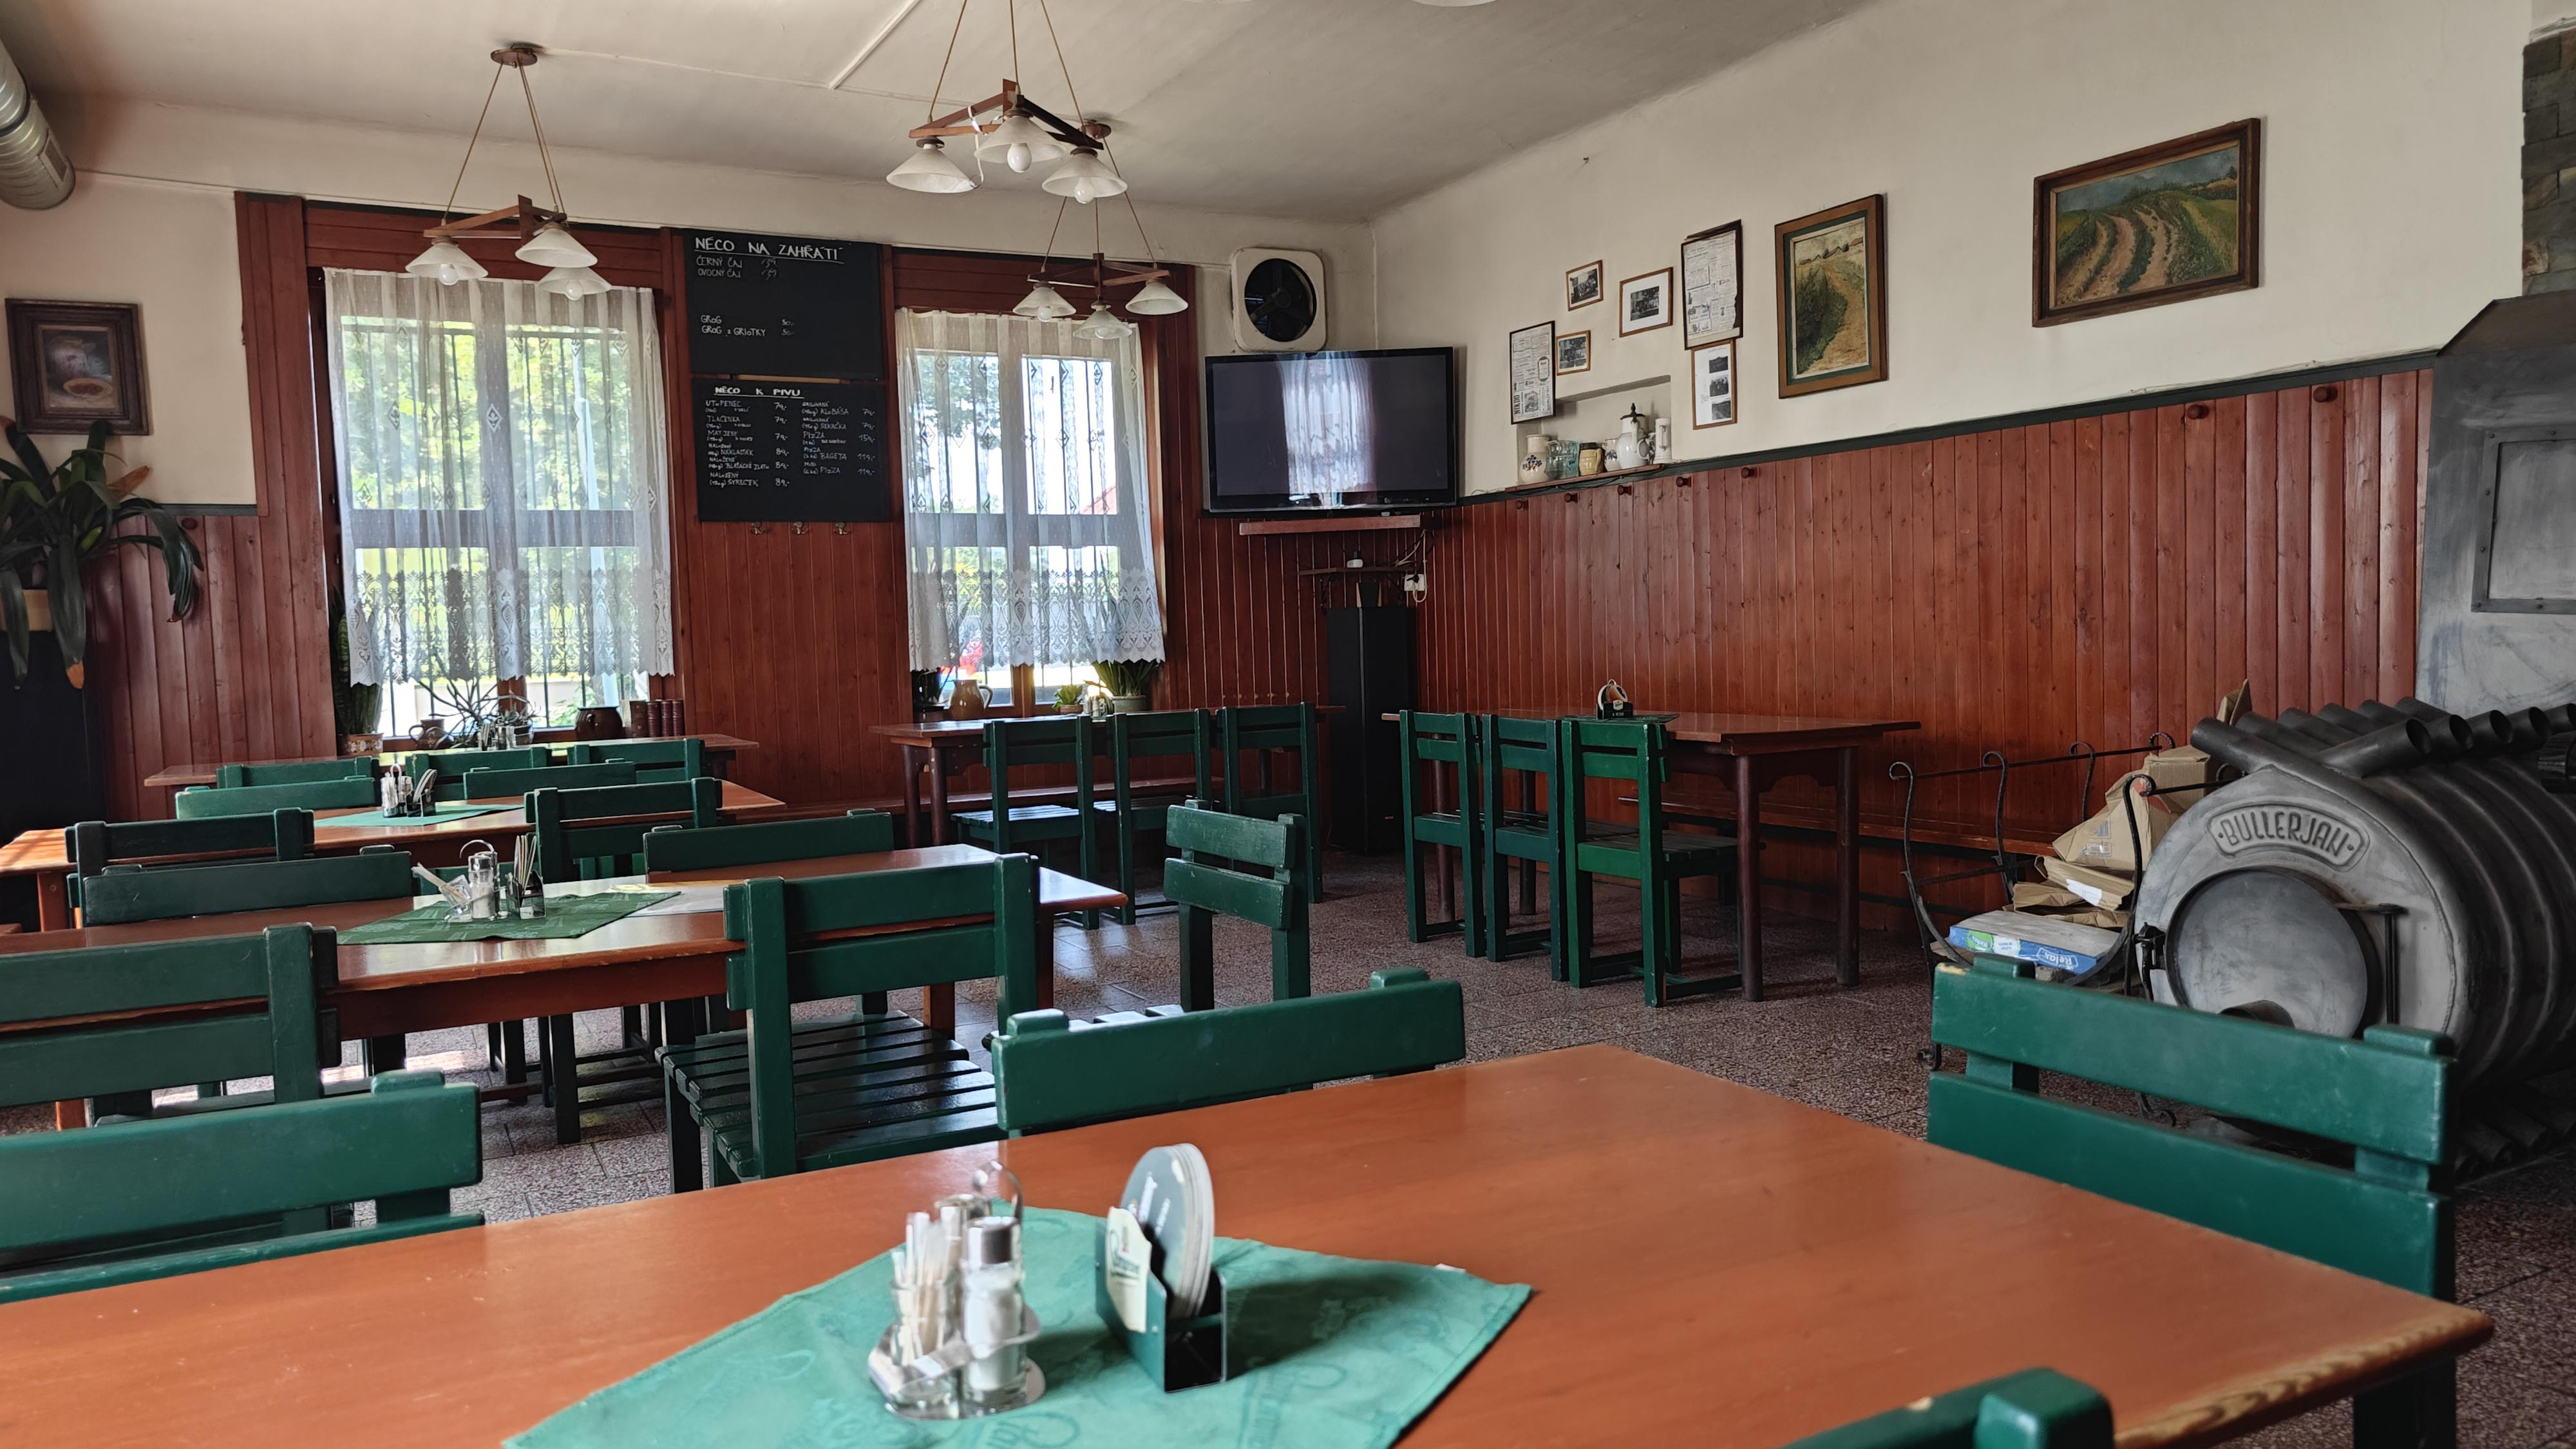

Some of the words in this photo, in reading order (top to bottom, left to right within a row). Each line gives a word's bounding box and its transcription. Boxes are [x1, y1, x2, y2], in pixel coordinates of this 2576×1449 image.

[748, 242, 770, 256] NA
[696, 255, 723, 266] ČERNÝ
[728, 257, 743, 269] ČAJ
[726, 268, 741, 278] ČAJ
[773, 388, 800, 397] PIVU
[819, 453, 848, 461] BAGETA
[2220, 811, 2349, 857] BULLERJAN
[2043, 952, 2072, 969] Relax
